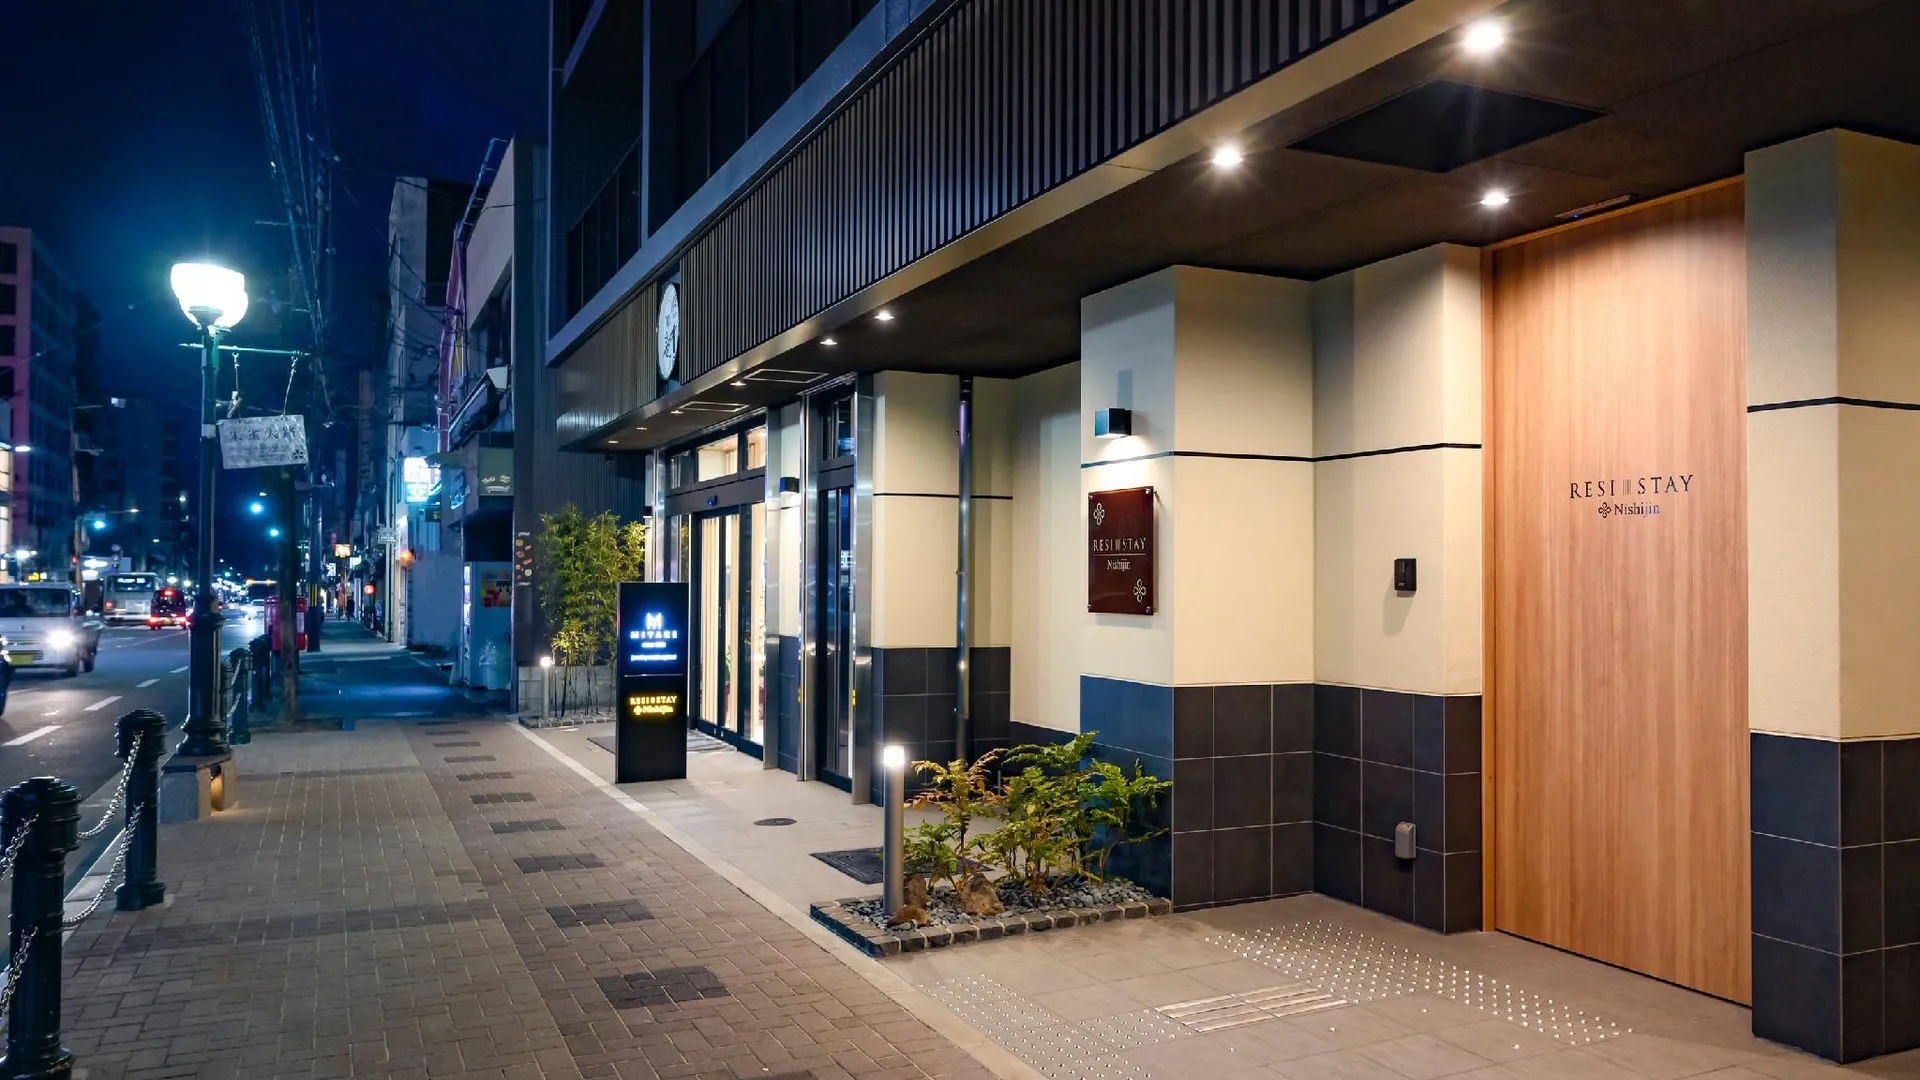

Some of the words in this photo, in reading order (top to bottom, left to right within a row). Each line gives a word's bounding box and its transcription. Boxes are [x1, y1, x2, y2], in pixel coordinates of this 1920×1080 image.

[1569, 480, 1616, 499] RESI
[1637, 474, 1694, 495] STAY
[1614, 501, 1661, 518] Nishijin
[1107, 558, 1131, 572] Nishijin
